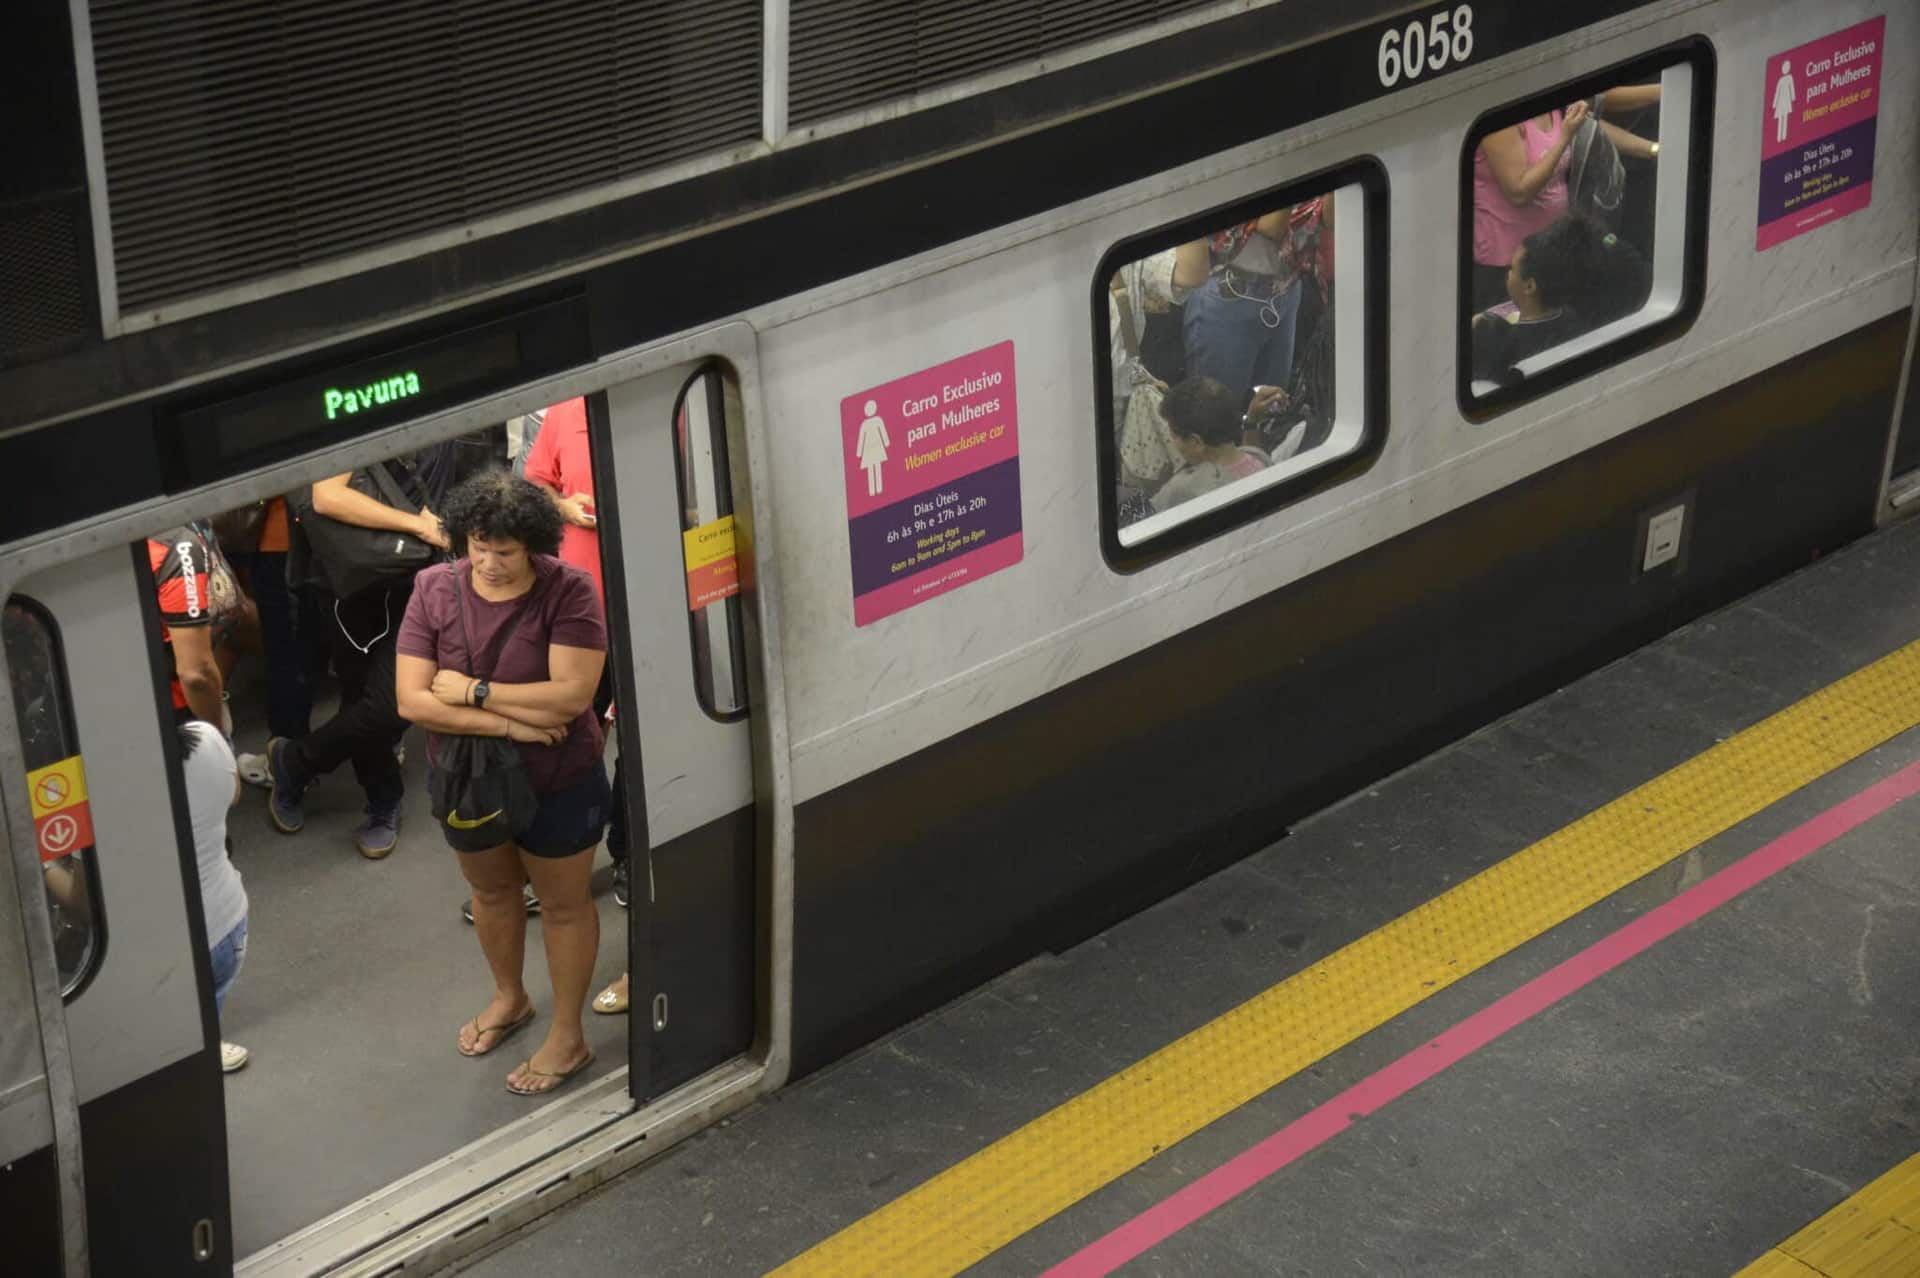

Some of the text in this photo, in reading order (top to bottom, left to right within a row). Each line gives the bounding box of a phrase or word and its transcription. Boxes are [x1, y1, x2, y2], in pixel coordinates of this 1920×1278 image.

[1378, 4, 1473, 88] 6058
[1806, 41, 1875, 77] Carro Exclusivo
[1806, 64, 1871, 104] para Mulheres
[324, 371, 420, 419] Pavuna
[902, 371, 1002, 417] Carro Exclusivo
[907, 398, 1000, 448] para Mulheres
[905, 424, 1006, 471] Women exclusive car
[887, 496, 987, 543] 6h às 9h e 17h às 20h
[914, 491, 959, 517] Dias Úteis
[176, 541, 200, 618] bozzano
